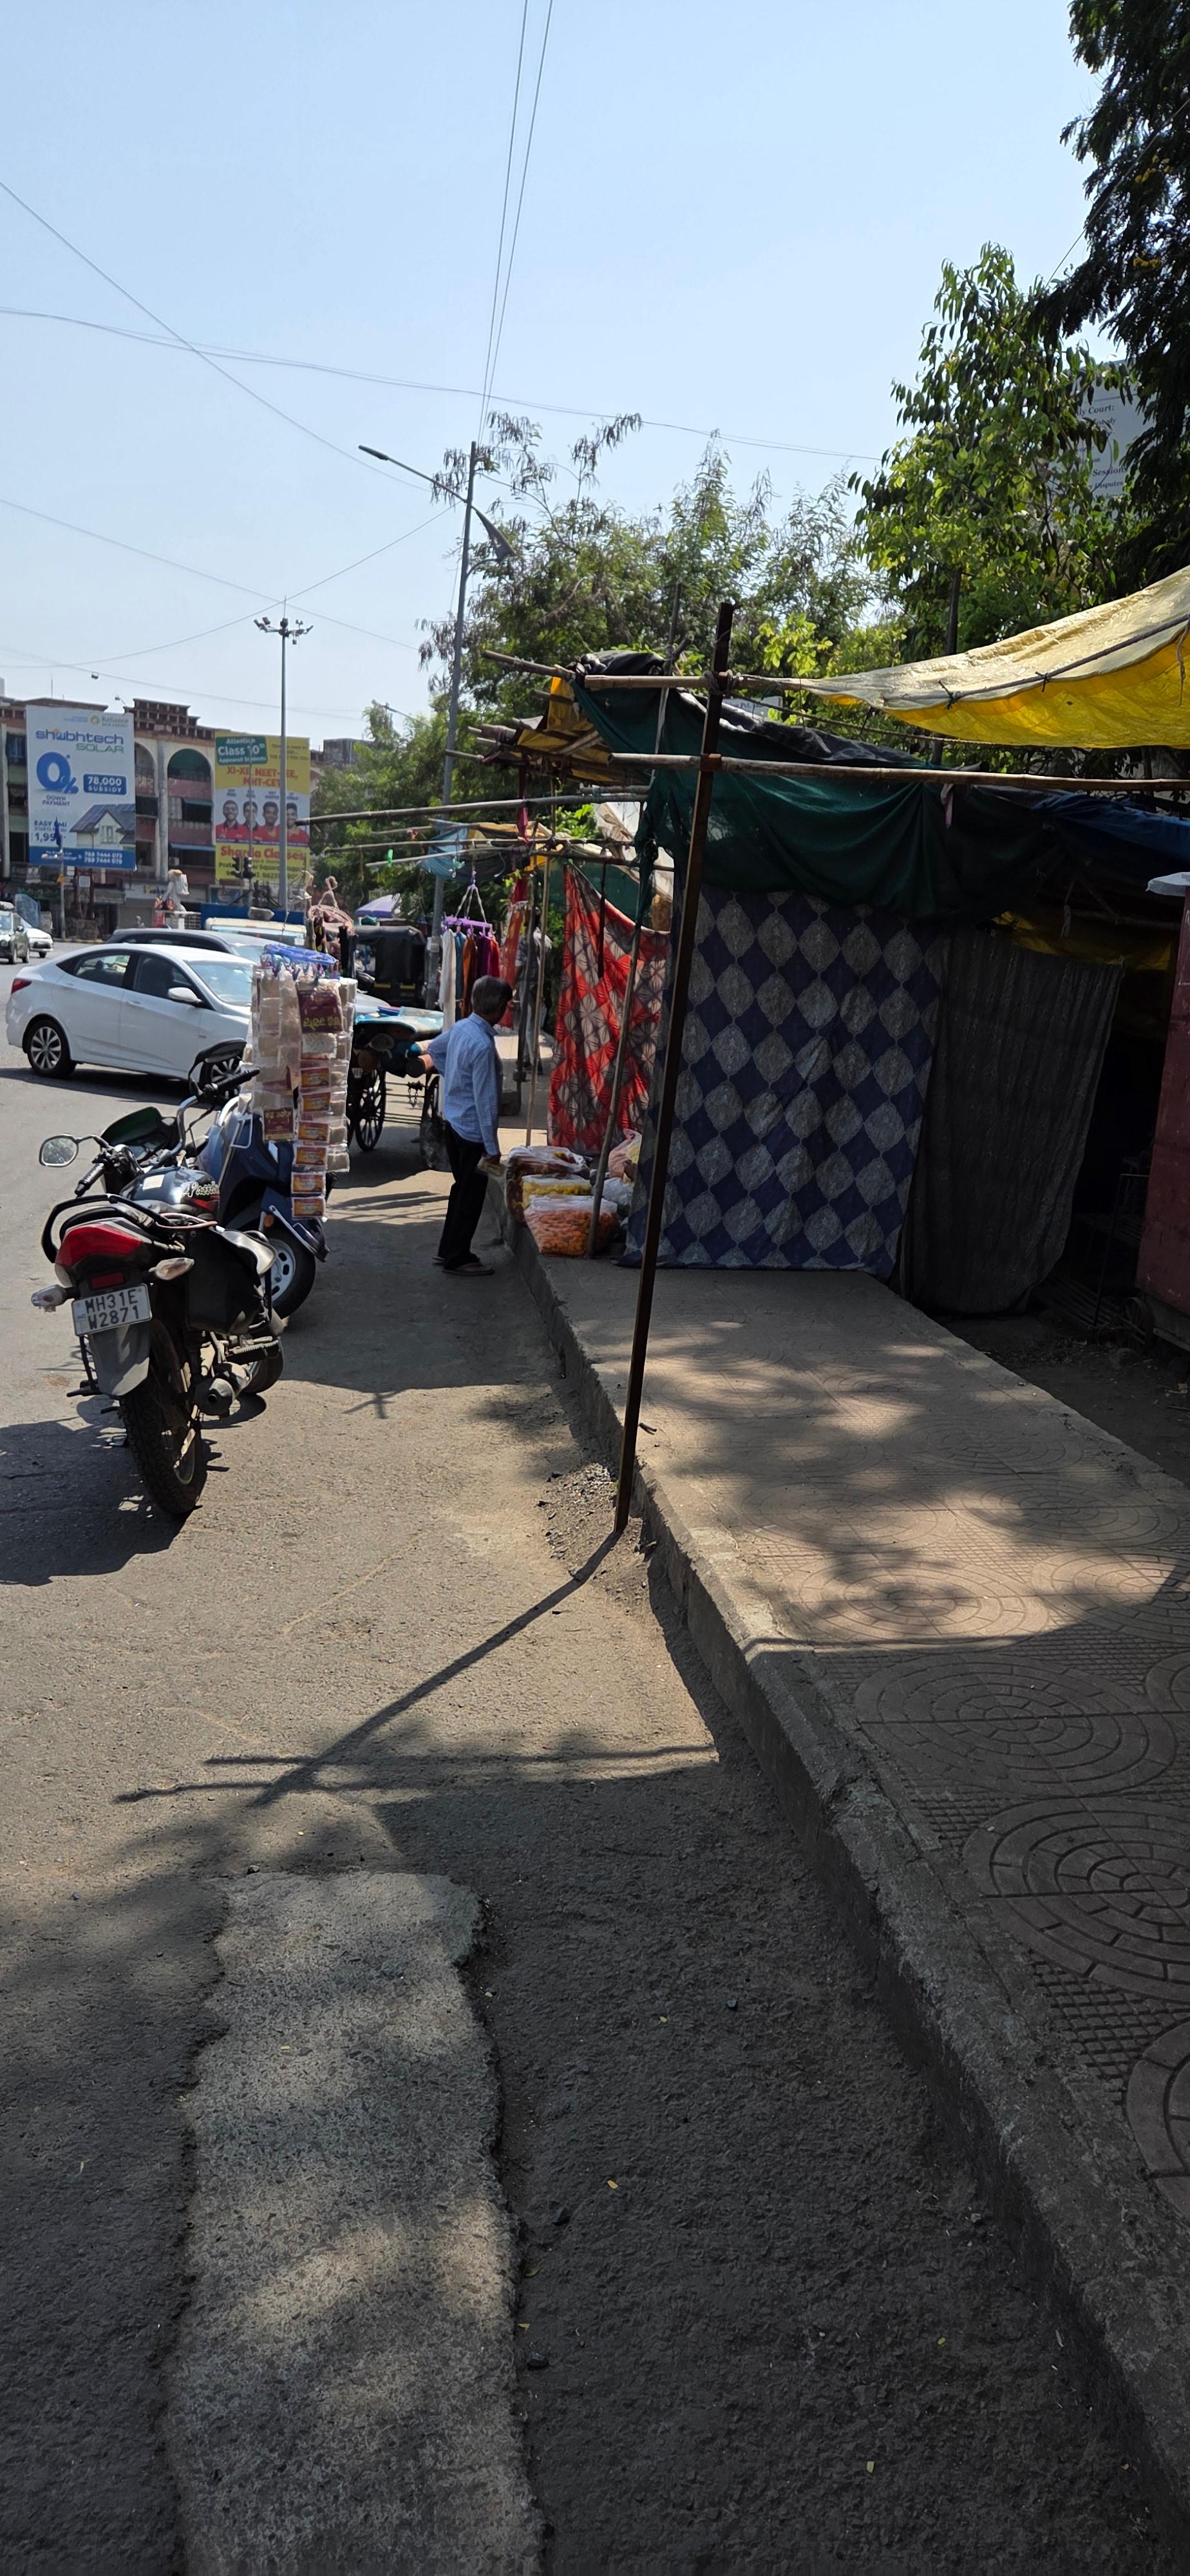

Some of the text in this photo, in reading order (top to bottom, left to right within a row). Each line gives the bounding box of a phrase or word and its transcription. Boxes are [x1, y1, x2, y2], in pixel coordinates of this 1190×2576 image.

[1088, 404, 1115, 414] Court:
[36, 728, 124, 744] shubhtech
[76, 743, 124, 753] SOLAR
[218, 746, 245, 755] Class
[255, 768, 298, 779] NEET-EE,
[88, 776, 122, 786] 78,000
[264, 848, 305, 860] Clases
[85, 1289, 138, 1314] MH31E
[88, 1305, 139, 1330] W2871
